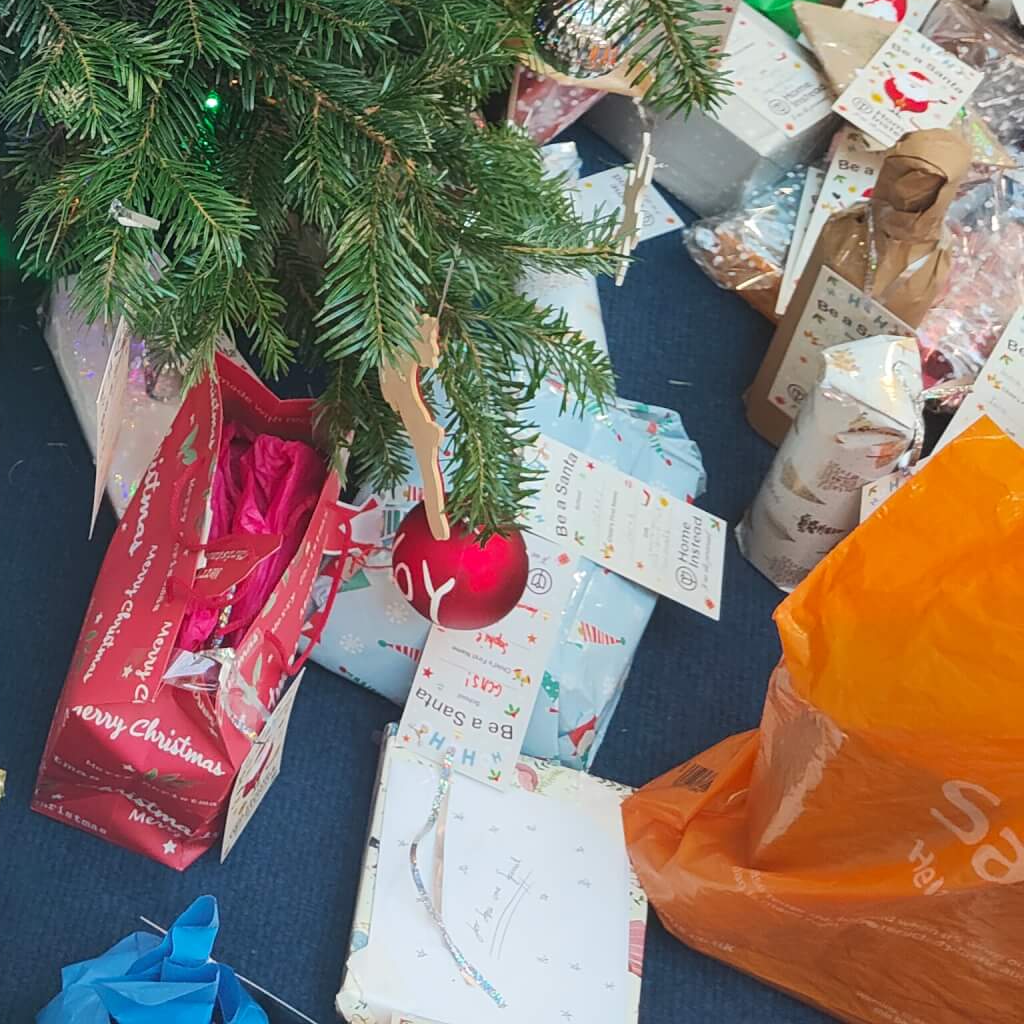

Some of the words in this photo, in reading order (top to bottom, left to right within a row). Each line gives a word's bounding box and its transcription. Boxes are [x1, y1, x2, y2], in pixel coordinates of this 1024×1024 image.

[838, 160, 859, 171] Be
[864, 167, 874, 175] a
[817, 299, 838, 317] Be
[555, 452, 578, 496] Santa
[556, 514, 568, 537] Be
[557, 500, 567, 510] a
[677, 522, 691, 564] Home
[688, 515, 703, 569] Instead
[125, 544, 158, 596] Merry
[83, 599, 133, 683] Christmas
[137, 621, 173, 678] Merry
[416, 686, 467, 727] Santa
[472, 719, 482, 729] a
[129, 717, 225, 776] Christmas
[488, 719, 513, 740] Be
